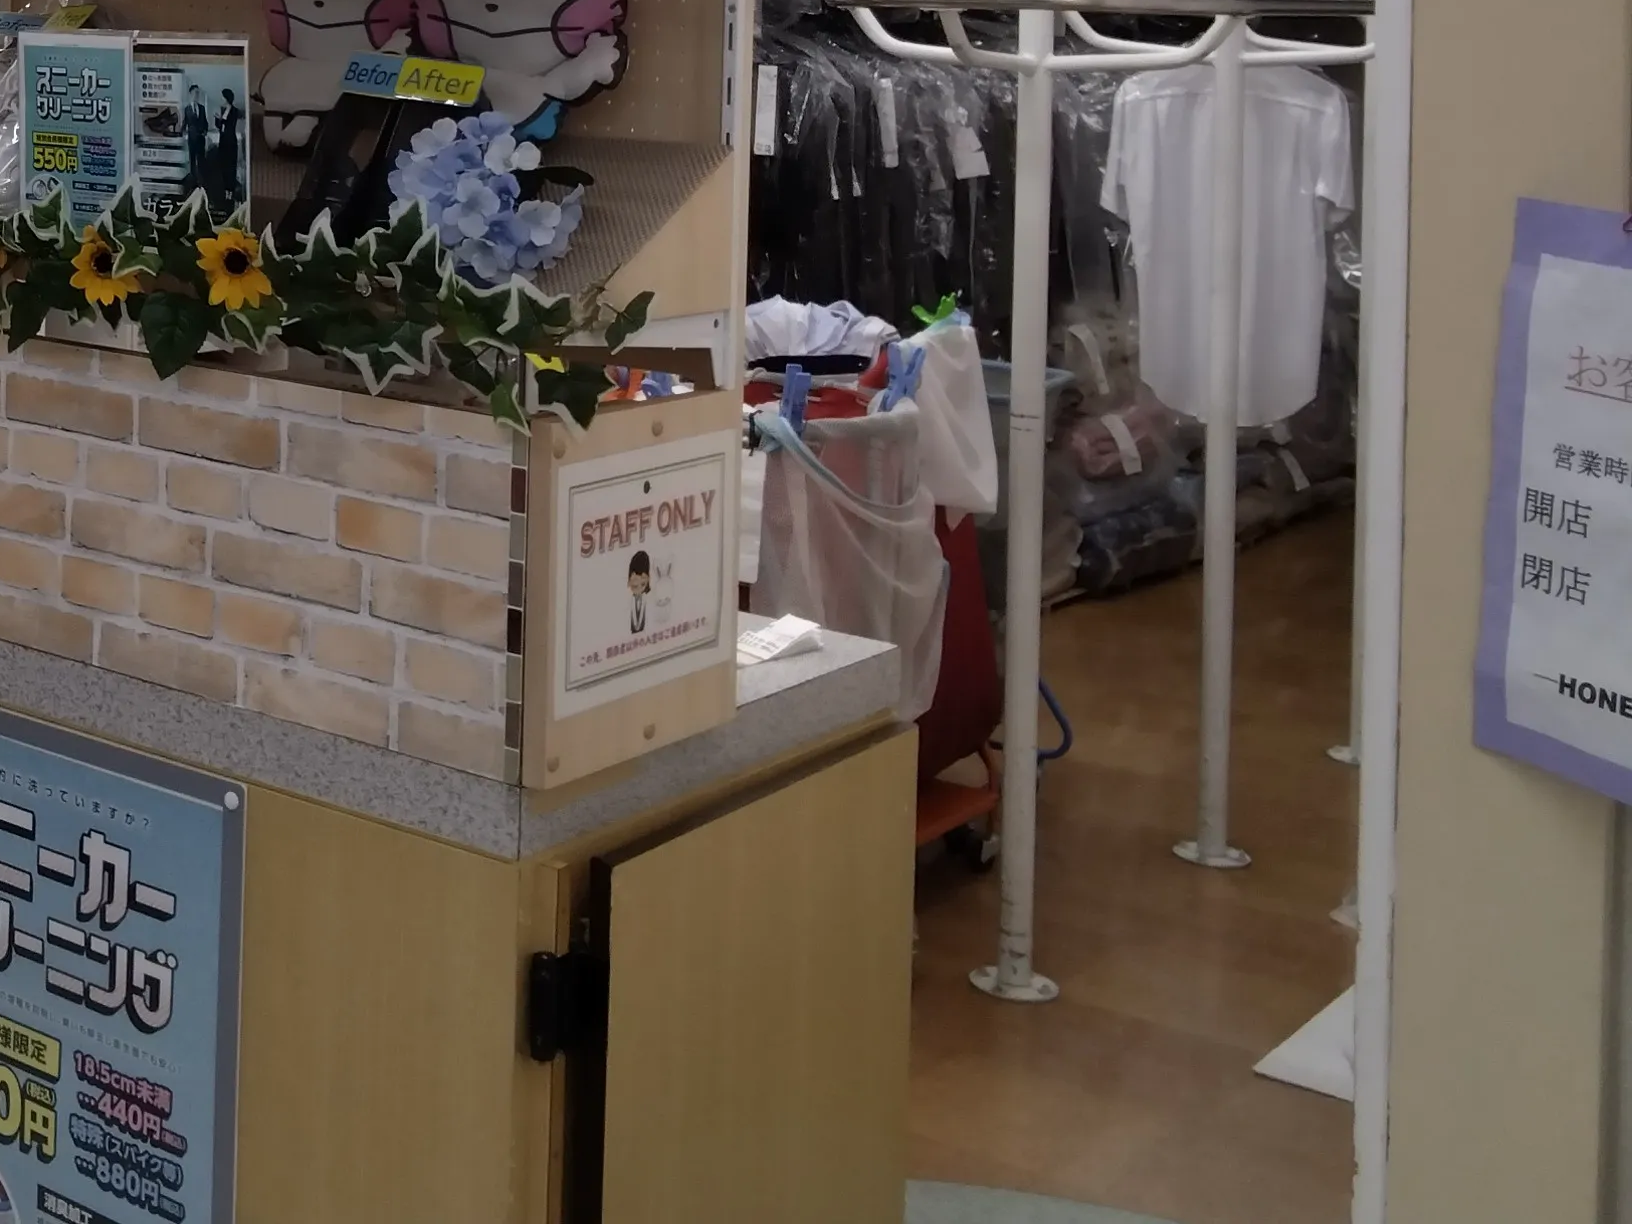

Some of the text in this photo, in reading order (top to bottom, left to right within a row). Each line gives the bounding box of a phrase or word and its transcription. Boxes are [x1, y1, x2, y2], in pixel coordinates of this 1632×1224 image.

[36, 65, 111, 96] スニーカー
[402, 68, 475, 95] After
[36, 96, 112, 123] クリーニング
[33, 147, 79, 173] 550円
[580, 489, 716, 557] STAFF ONLY
[1523, 487, 1592, 538] 開店
[1521, 553, 1592, 605] 閉店
[74, 1051, 171, 1114] 18.5cm未満
